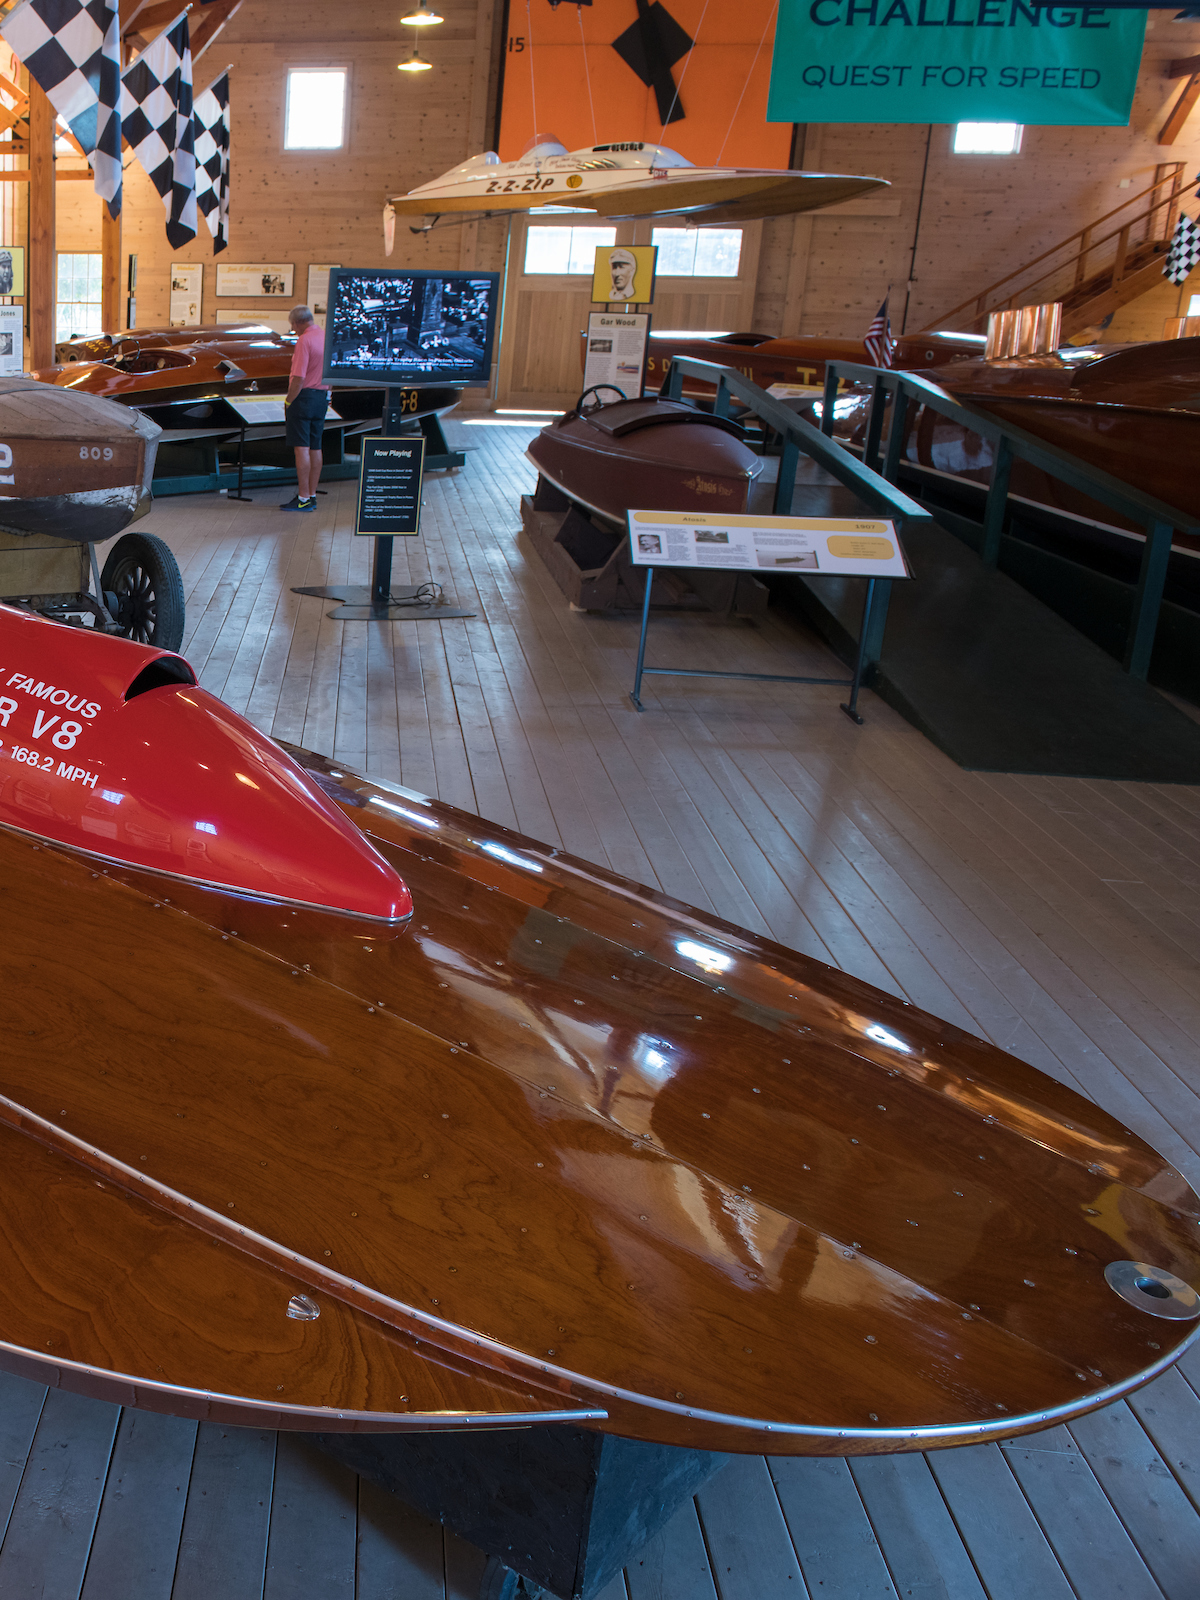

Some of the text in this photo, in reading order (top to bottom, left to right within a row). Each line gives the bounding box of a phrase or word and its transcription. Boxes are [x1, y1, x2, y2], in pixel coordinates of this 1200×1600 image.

[810, 0, 1110, 28] CHALLENGE
[509, 37, 524, 52] 15
[802, 65, 1101, 89] QUEST FOR SPEED
[486, 178, 554, 193] Z-Z-ZIP
[79, 446, 113, 460] 809
[6, 674, 102, 719] FAMOUS
[31, 708, 82, 751] V8
[11, 745, 55, 772] 168.2
[56, 762, 99, 789] MPH
